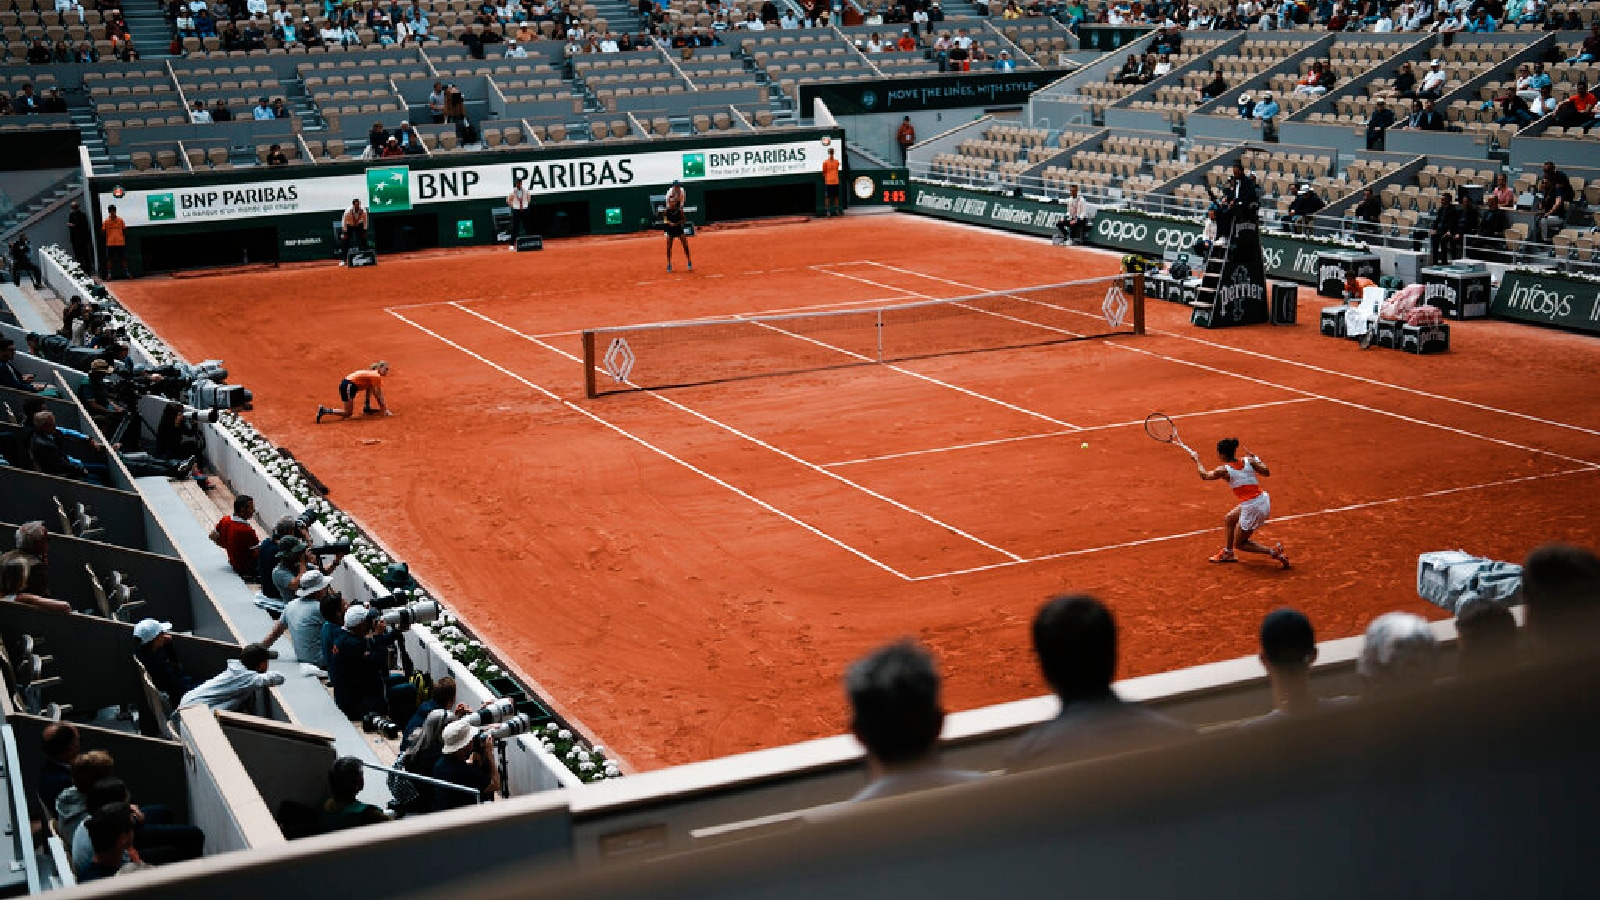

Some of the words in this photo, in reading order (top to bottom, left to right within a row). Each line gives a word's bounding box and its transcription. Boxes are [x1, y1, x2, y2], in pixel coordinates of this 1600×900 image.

[888, 89, 919, 106] MOVE
[922, 87, 941, 104] THE
[977, 83, 1003, 100] WITH
[709, 151, 740, 167] BNP
[744, 148, 806, 166] PARIBAS
[418, 170, 480, 199] BNP
[512, 158, 634, 192] PARIBAS
[180, 192, 217, 209] BNP
[222, 185, 298, 205] PARIBAS
[916, 190, 953, 210] Emirates
[991, 202, 1034, 225] Emirates
[1098, 219, 1147, 241] oppo
[1507, 280, 1574, 320] Infosys
